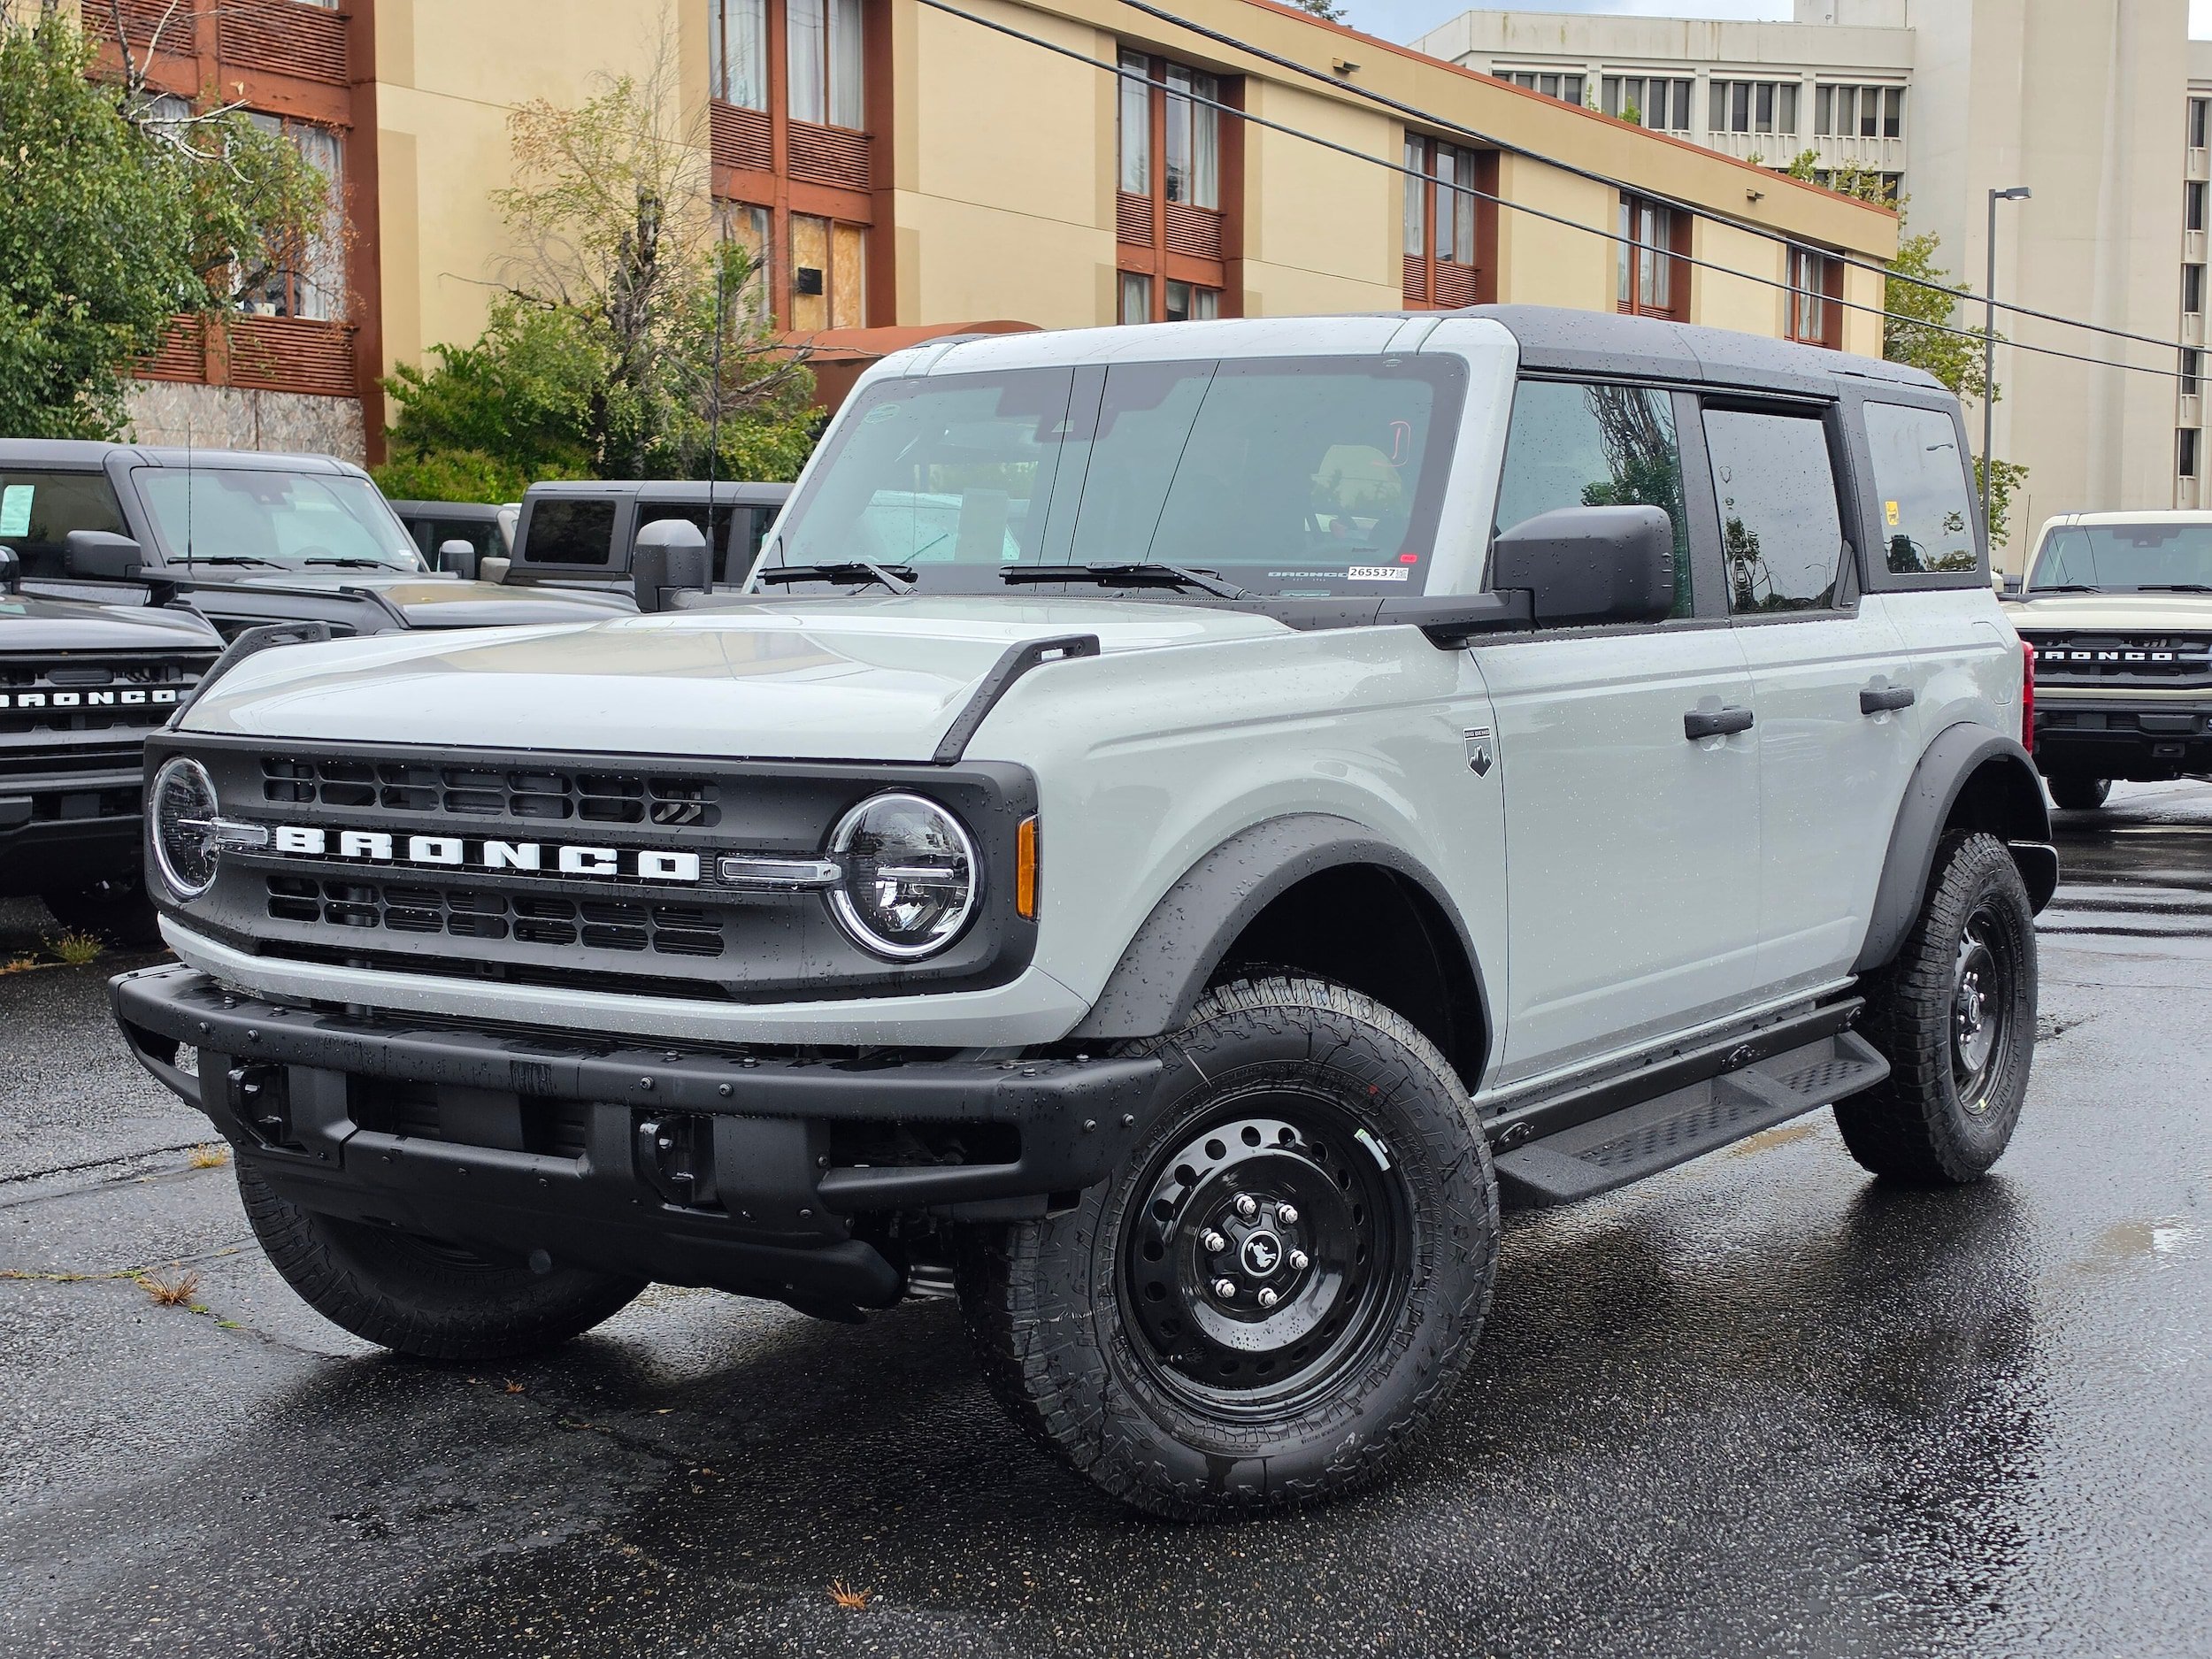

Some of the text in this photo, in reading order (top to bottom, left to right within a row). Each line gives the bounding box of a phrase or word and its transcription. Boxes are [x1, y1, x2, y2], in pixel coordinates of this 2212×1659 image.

[1350, 568, 1395, 577] 265537
[2033, 651, 2173, 661] RONCO
[276, 826, 700, 881] BRONCO
